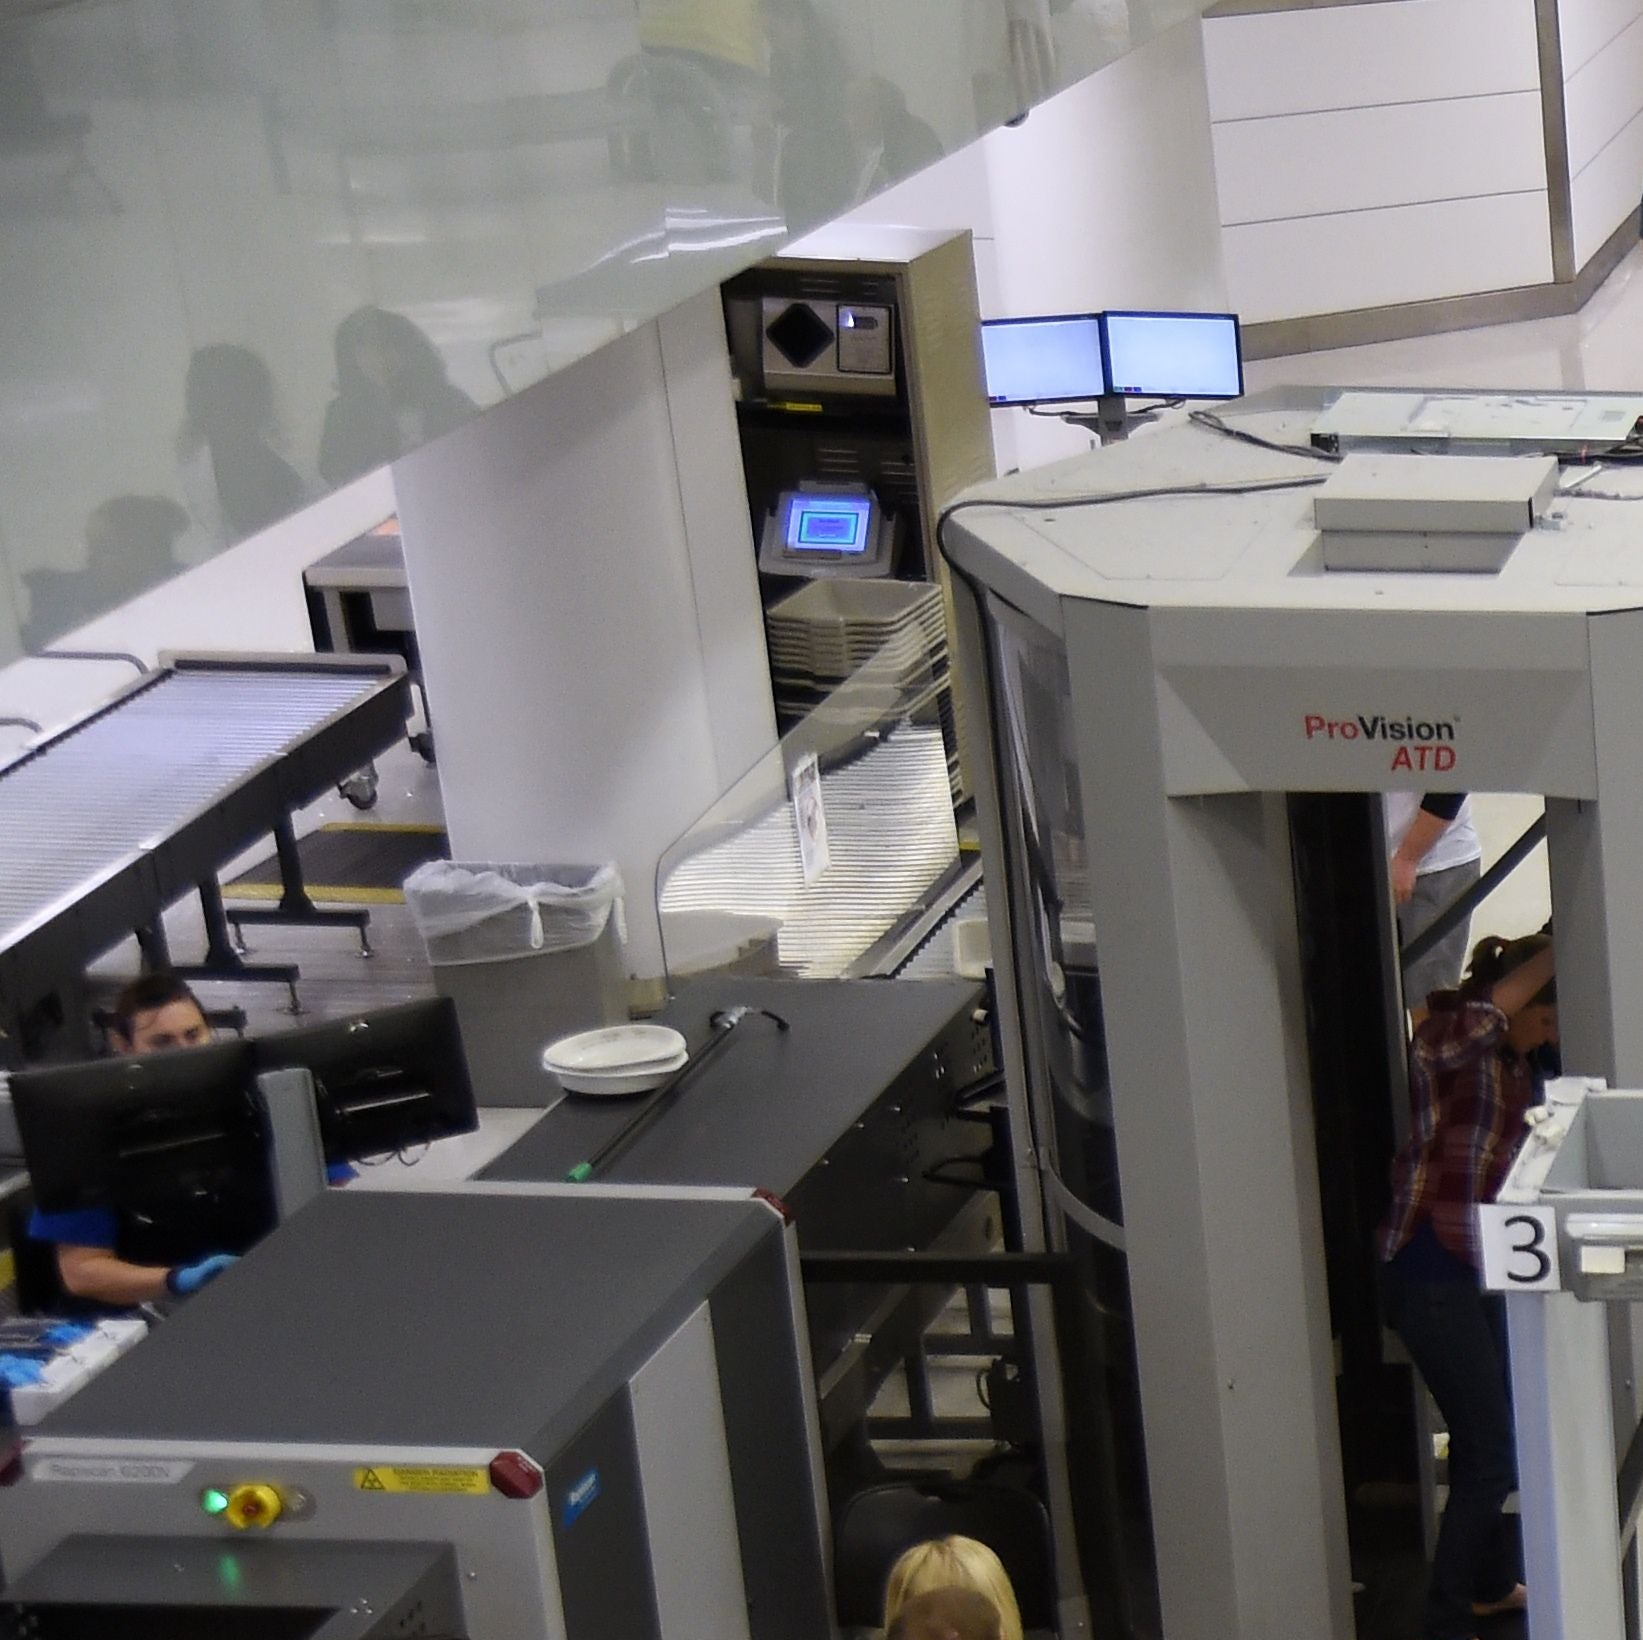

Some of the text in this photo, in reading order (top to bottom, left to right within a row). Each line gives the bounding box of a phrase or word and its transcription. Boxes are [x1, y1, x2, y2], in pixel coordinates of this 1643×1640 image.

[1304, 714, 1455, 741] ProVision
[1391, 745, 1457, 771] ATD
[1504, 1215, 1551, 1283] 3
